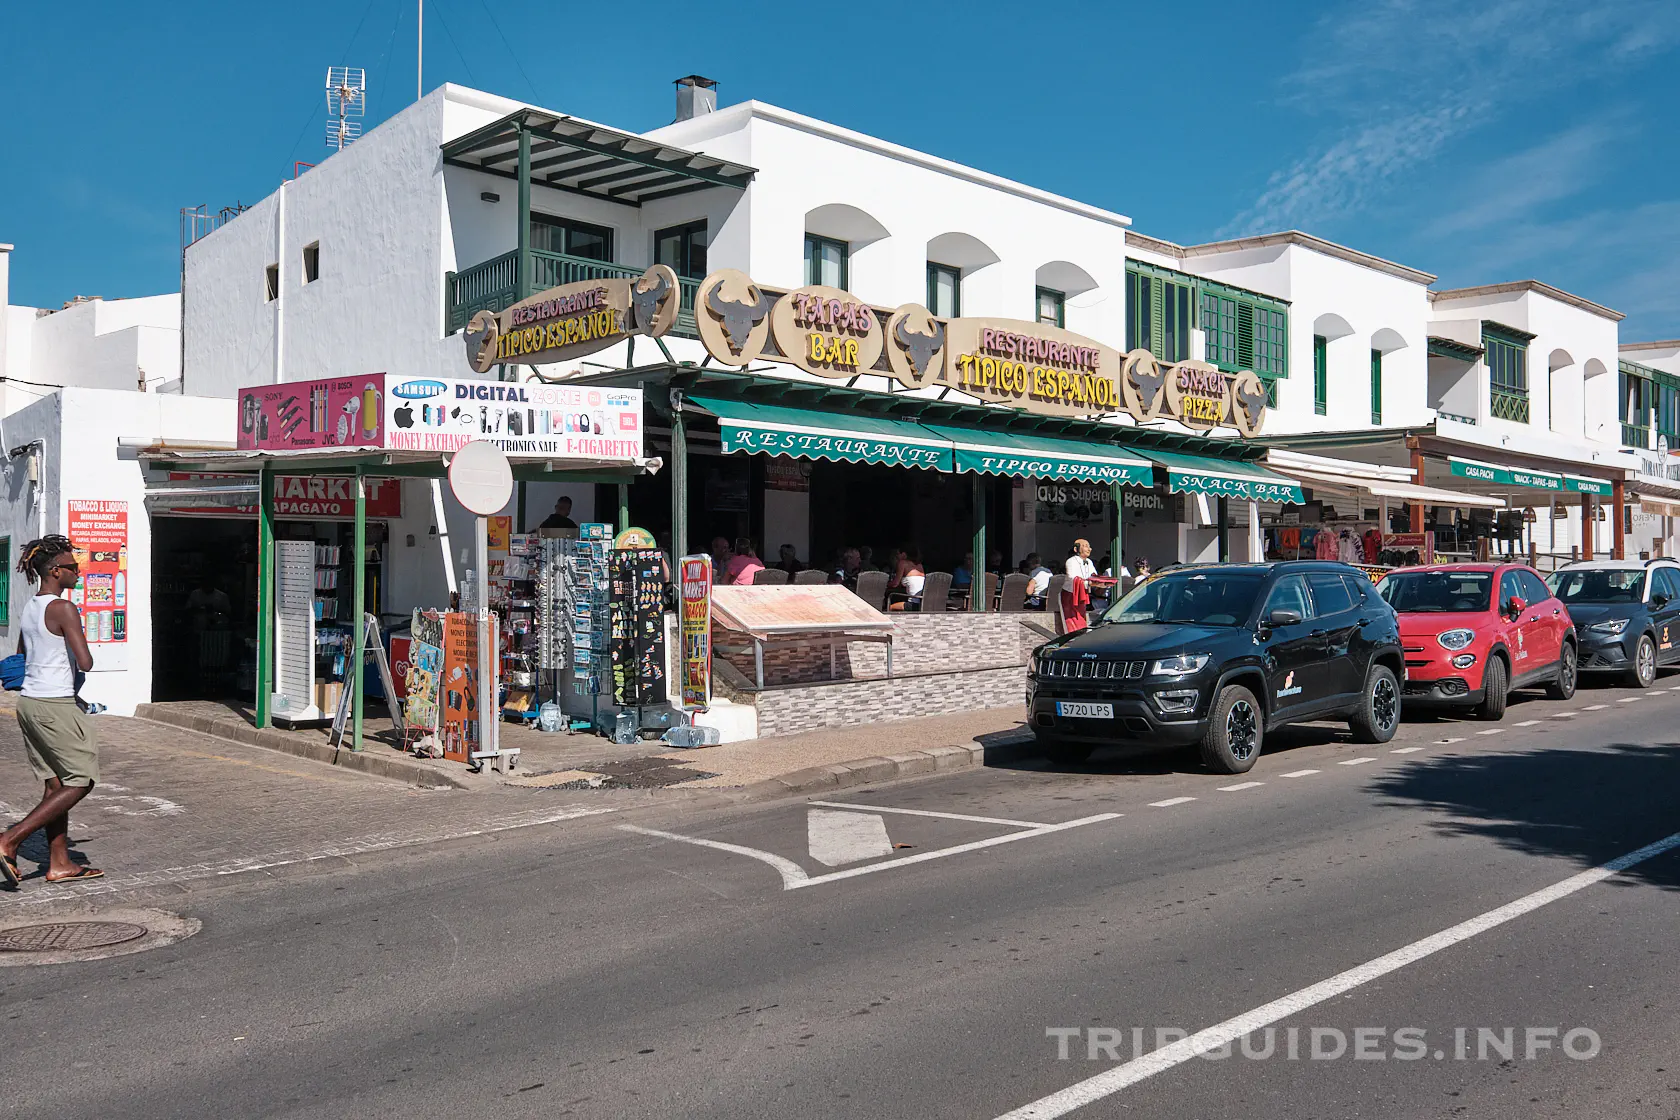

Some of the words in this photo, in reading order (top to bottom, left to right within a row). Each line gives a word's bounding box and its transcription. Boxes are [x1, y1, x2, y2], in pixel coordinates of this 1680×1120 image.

[512, 287, 605, 326] RESTAURANTE
[793, 293, 873, 333] TAPAS
[546, 307, 620, 349] ESPAÑOL
[808, 333, 860, 367] BAR
[983, 327, 1100, 369] RESTAURANTE
[959, 352, 1028, 392] TÍPICO
[1033, 367, 1119, 408] ESPAÑOL
[1179, 366, 1227, 394] SNACK
[264, 392, 283, 401] SONY
[397, 384, 445, 396] SAMSUNG
[455, 384, 529, 402] DIGITAL
[532, 388, 580, 406] ZONE
[1183, 396, 1225, 422] PIZZA
[622, 416, 635, 426] JBL
[291, 437, 316, 446] Panasonic
[322, 434, 335, 446] JVC
[390, 432, 422, 449] MONEY
[425, 433, 472, 450] EXCHANGE
[538, 440, 558, 452] SALE
[567, 439, 639, 456] E-CIGARETTS
[735, 430, 941, 464] RESTAURANTE
[1056, 464, 1131, 480] ESPAÑOL
[1466, 466, 1479, 476] CASA
[1480, 468, 1494, 479] PACHI
[1514, 474, 1530, 484] SNACK
[1532, 476, 1546, 486] TAPAS
[1178, 476, 1248, 492] SNACK
[1255, 484, 1294, 498] BAR
[70, 500, 98, 512] TOBACCO
[100, 501, 104, 512] &
[105, 501, 128, 512] LIQUOR
[274, 502, 340, 514] APAGAYO
[1124, 492, 1164, 510] Bench.
[688, 562, 702, 580] MINI
[683, 580, 706, 598] MARKET
[1062, 704, 1088, 716] 5720
[1090, 705, 1110, 716] LPS
